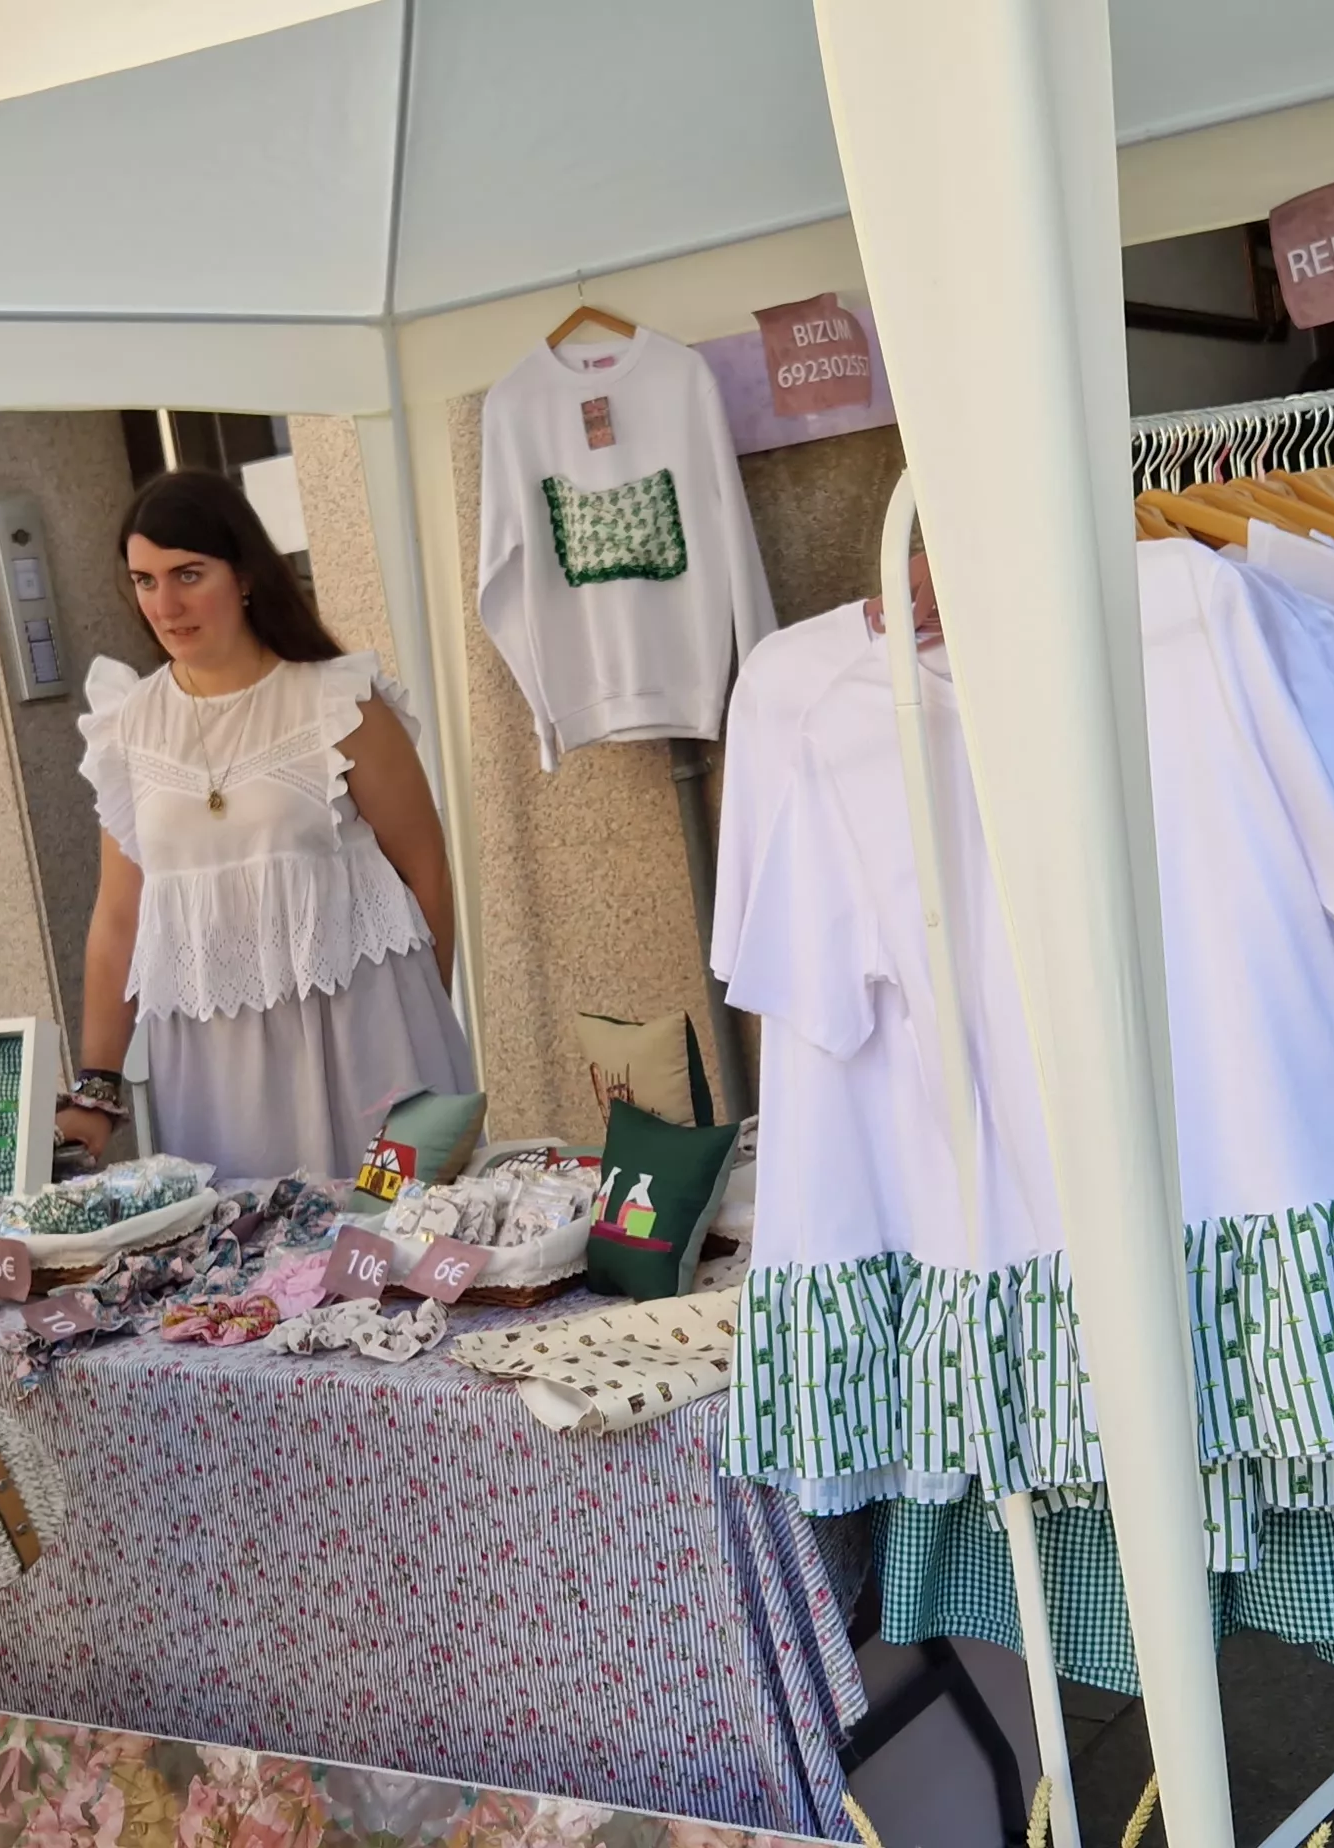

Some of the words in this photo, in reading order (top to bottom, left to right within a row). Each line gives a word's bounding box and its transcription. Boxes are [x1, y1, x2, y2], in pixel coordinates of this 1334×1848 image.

[792, 319, 852, 347] BIZUM
[347, 1249, 387, 1287] 10€
[434, 1257, 470, 1287] 6€
